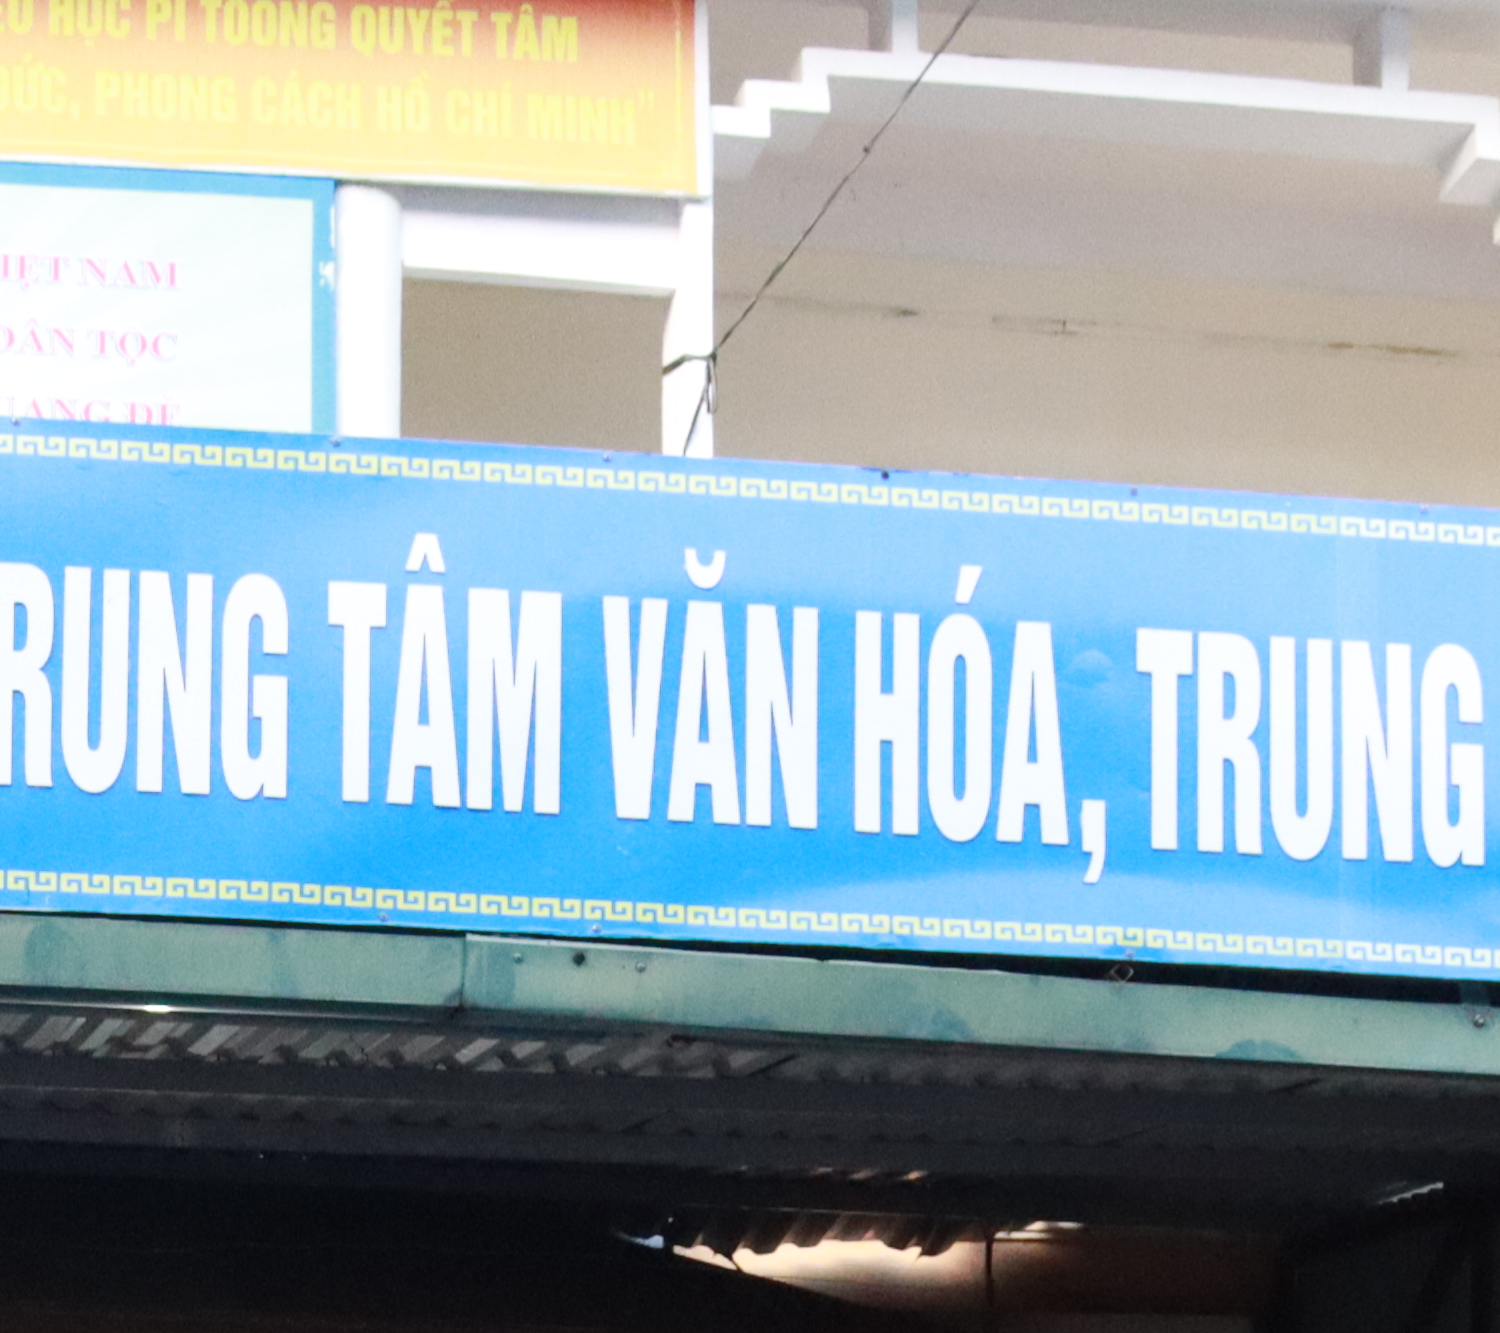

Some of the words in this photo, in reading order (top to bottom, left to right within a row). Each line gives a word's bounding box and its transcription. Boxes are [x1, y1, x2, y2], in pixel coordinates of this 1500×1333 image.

[144, 0, 188, 41] PI
[200, 0, 338, 48] TOONG
[351, 0, 478, 57] QUYẾT
[490, 3, 579, 64] TÂM
[93, 68, 238, 124] PHONG
[252, 66, 361, 131] CÁCH
[375, 72, 430, 134] HỒ
[451, 77, 512, 137] CHÍ
[526, 88, 657, 145] MINH”
[79, 256, 180, 290] NAM
[85, 329, 180, 367] TỌC
[327, 532, 564, 818] TÂM
[601, 548, 821, 832] VĂN
[853, 564, 1109, 885] HÓA,
[1137, 628, 1485, 870] TRUNG
